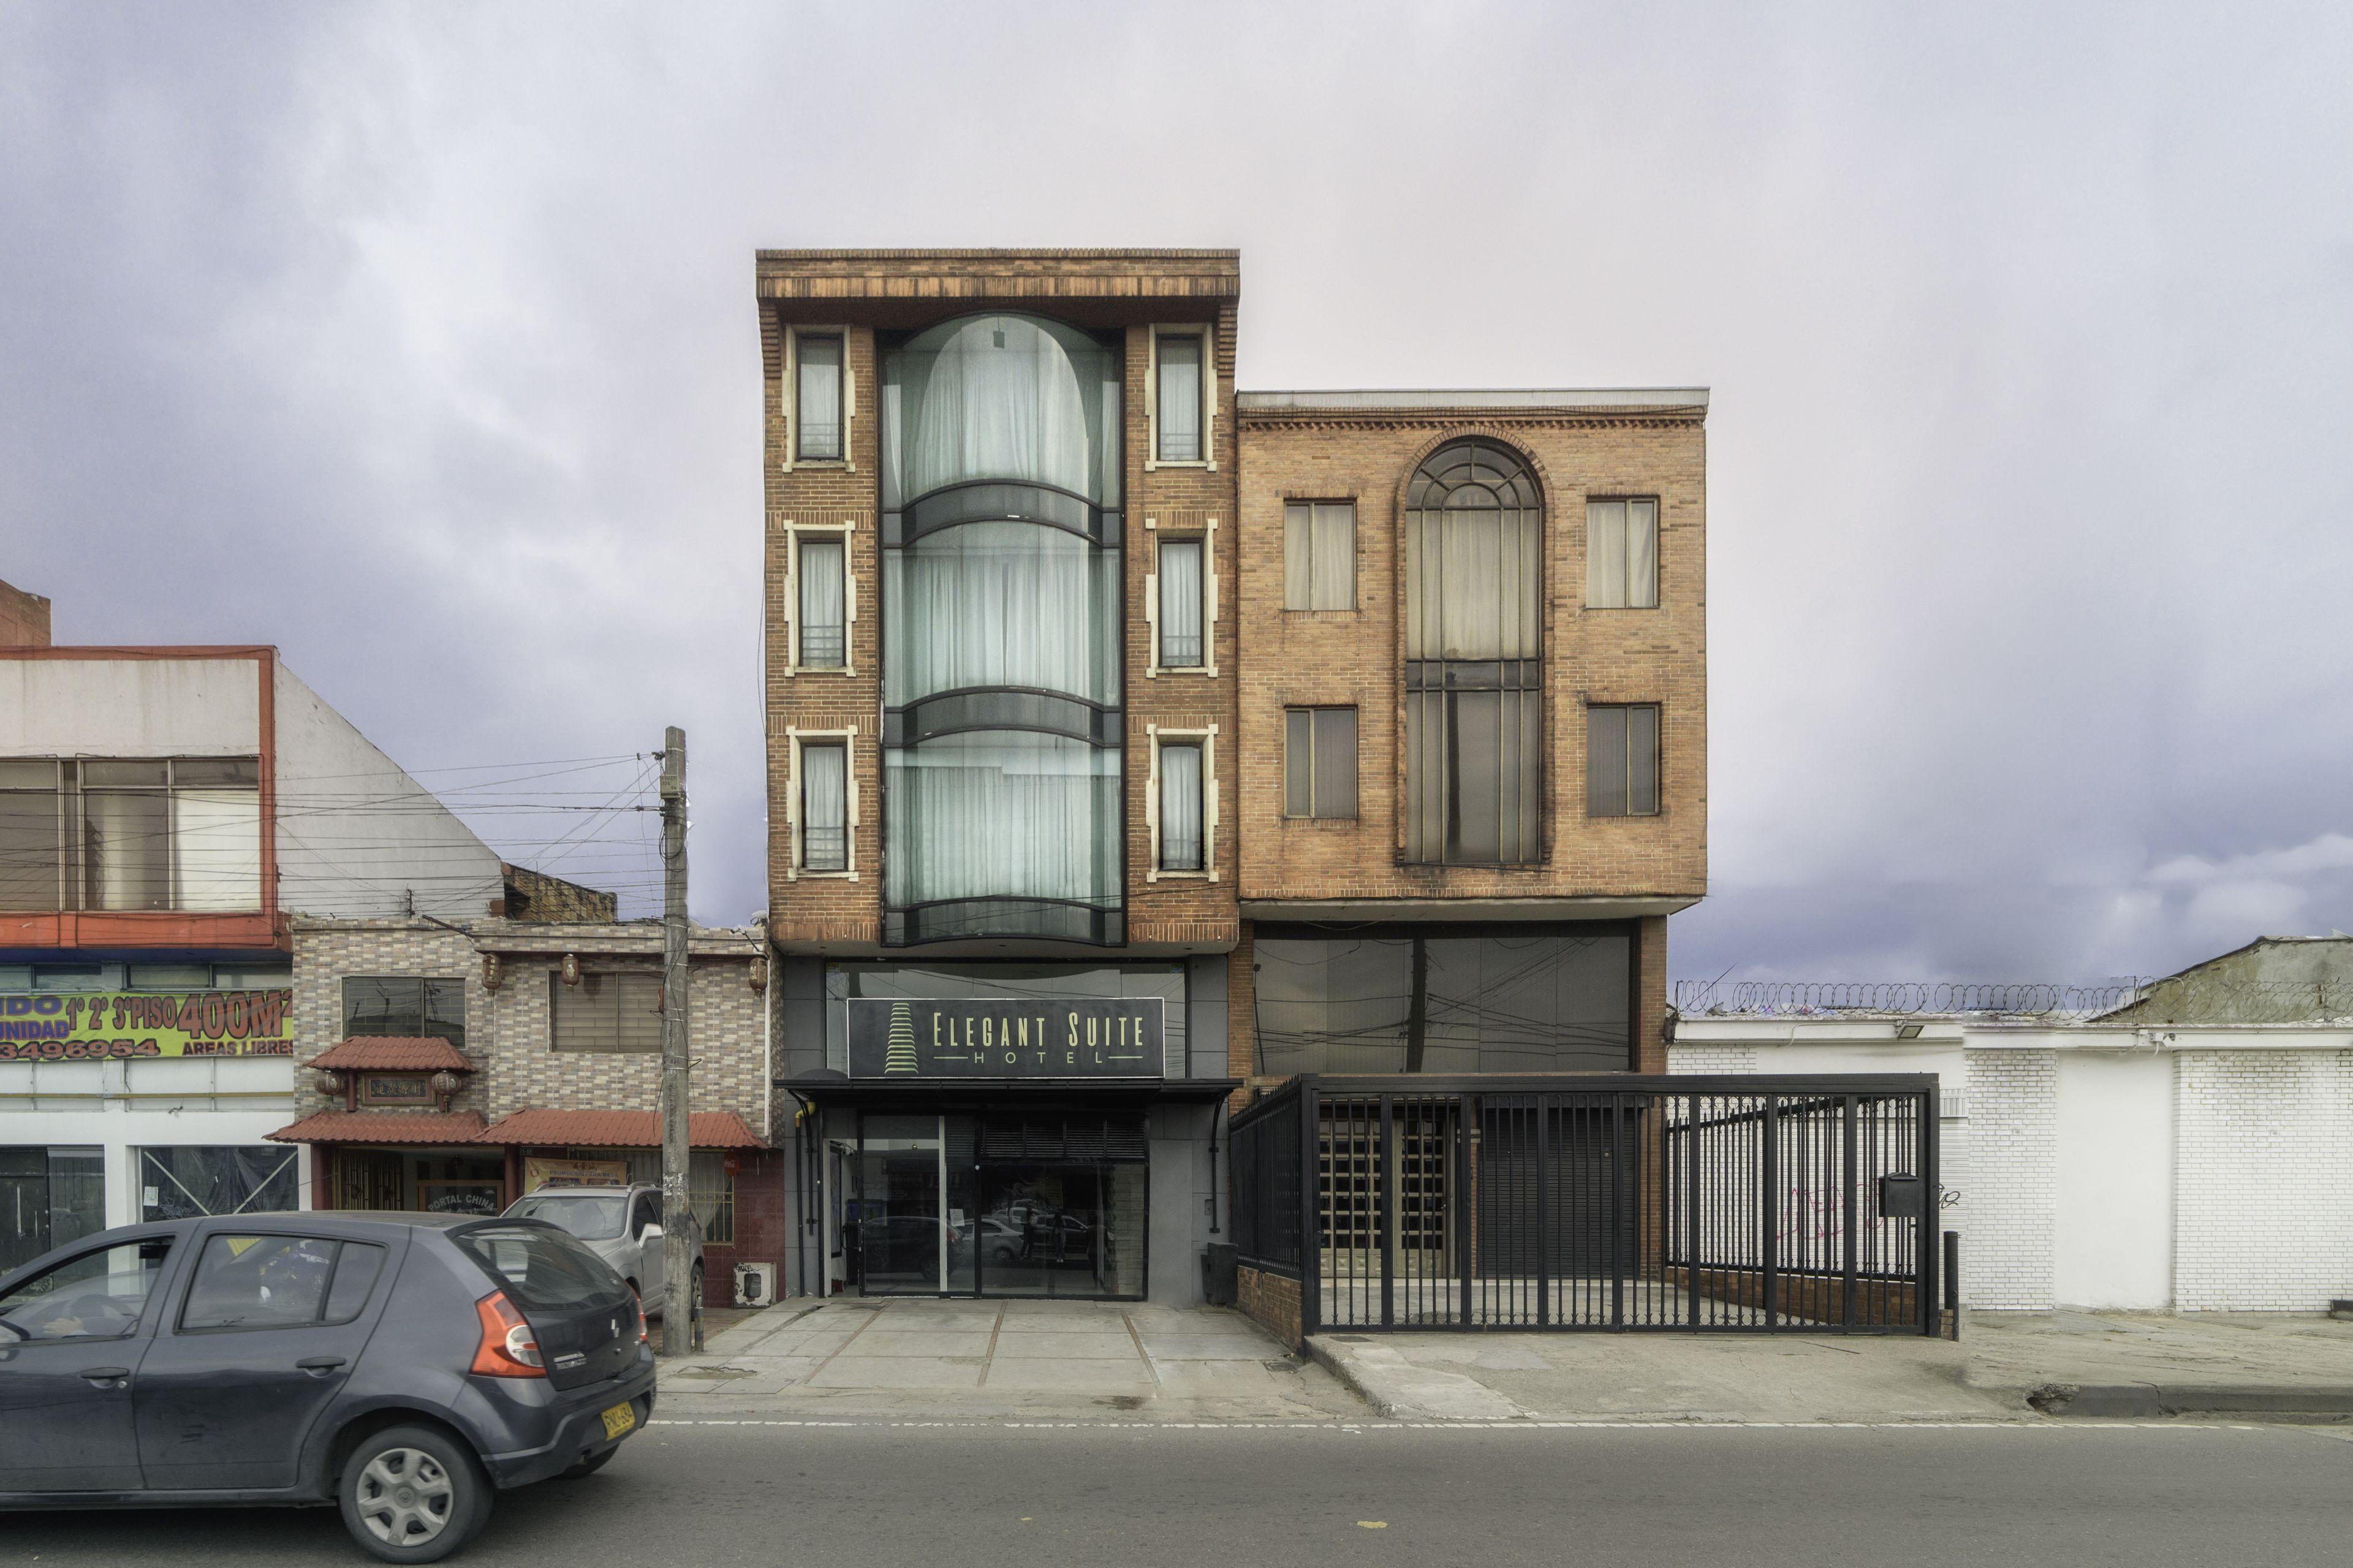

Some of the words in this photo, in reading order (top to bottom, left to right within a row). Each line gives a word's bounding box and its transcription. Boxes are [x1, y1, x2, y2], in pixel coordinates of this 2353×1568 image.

[933, 1012, 1045, 1047] ELEGANT
[1068, 1012, 1143, 1046] SUITE
[182, 1040, 238, 1056] AREAS
[975, 1052, 1102, 1064] HOTEL
[428, 1195, 462, 1211] PORTAL
[466, 1194, 494, 1211] CHINA
